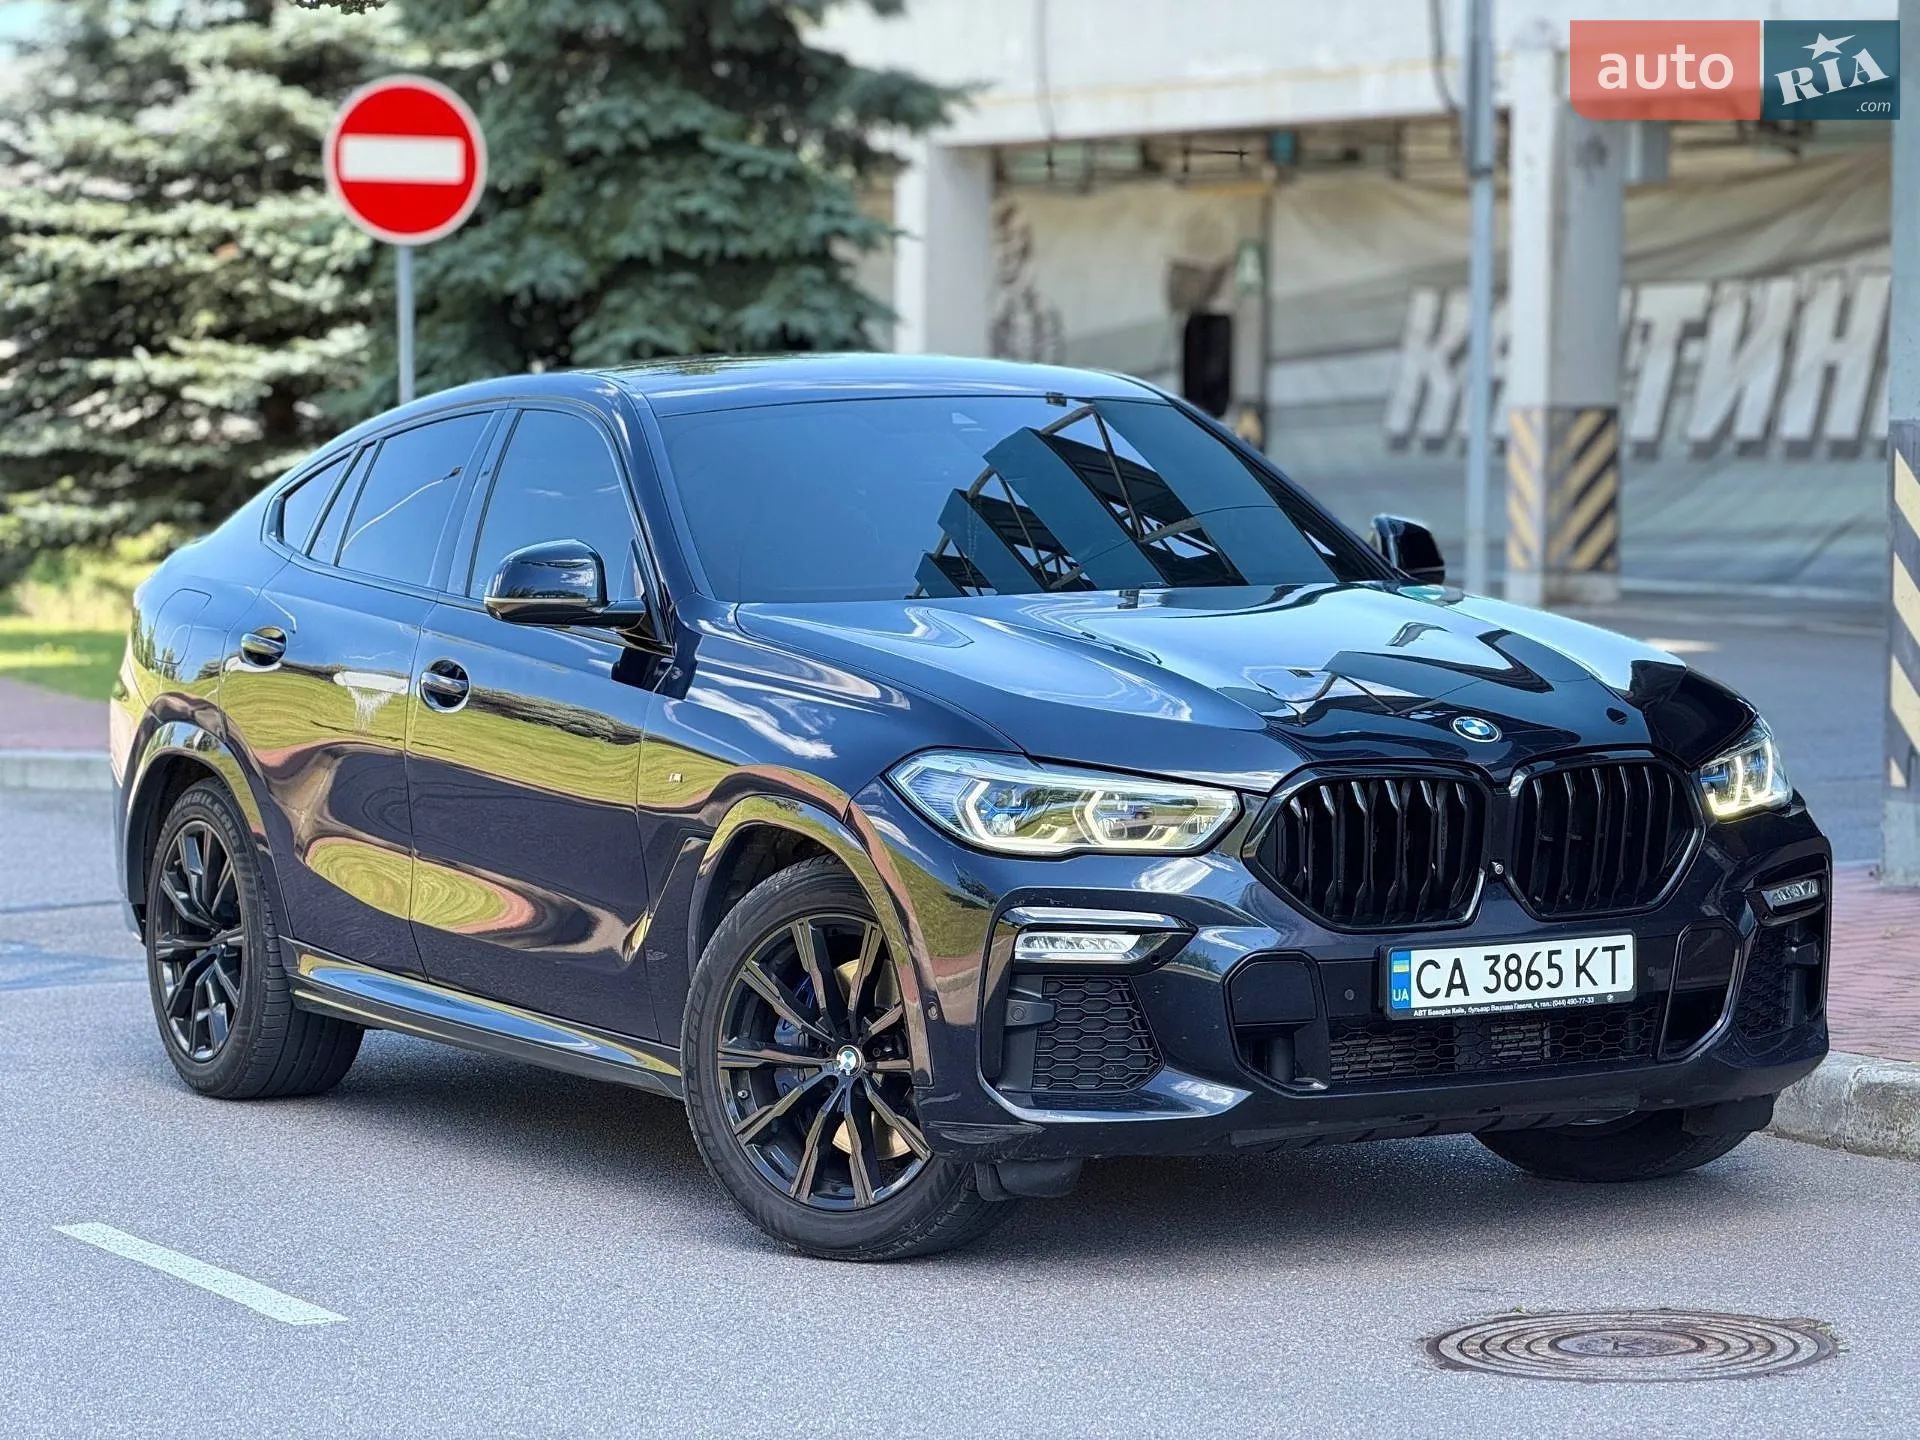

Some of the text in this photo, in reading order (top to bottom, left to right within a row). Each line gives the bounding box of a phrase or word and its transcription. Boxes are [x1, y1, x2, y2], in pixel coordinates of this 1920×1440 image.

[1416, 945, 1626, 999] CA 3865 KT
[1393, 988, 1410, 1001] UA
